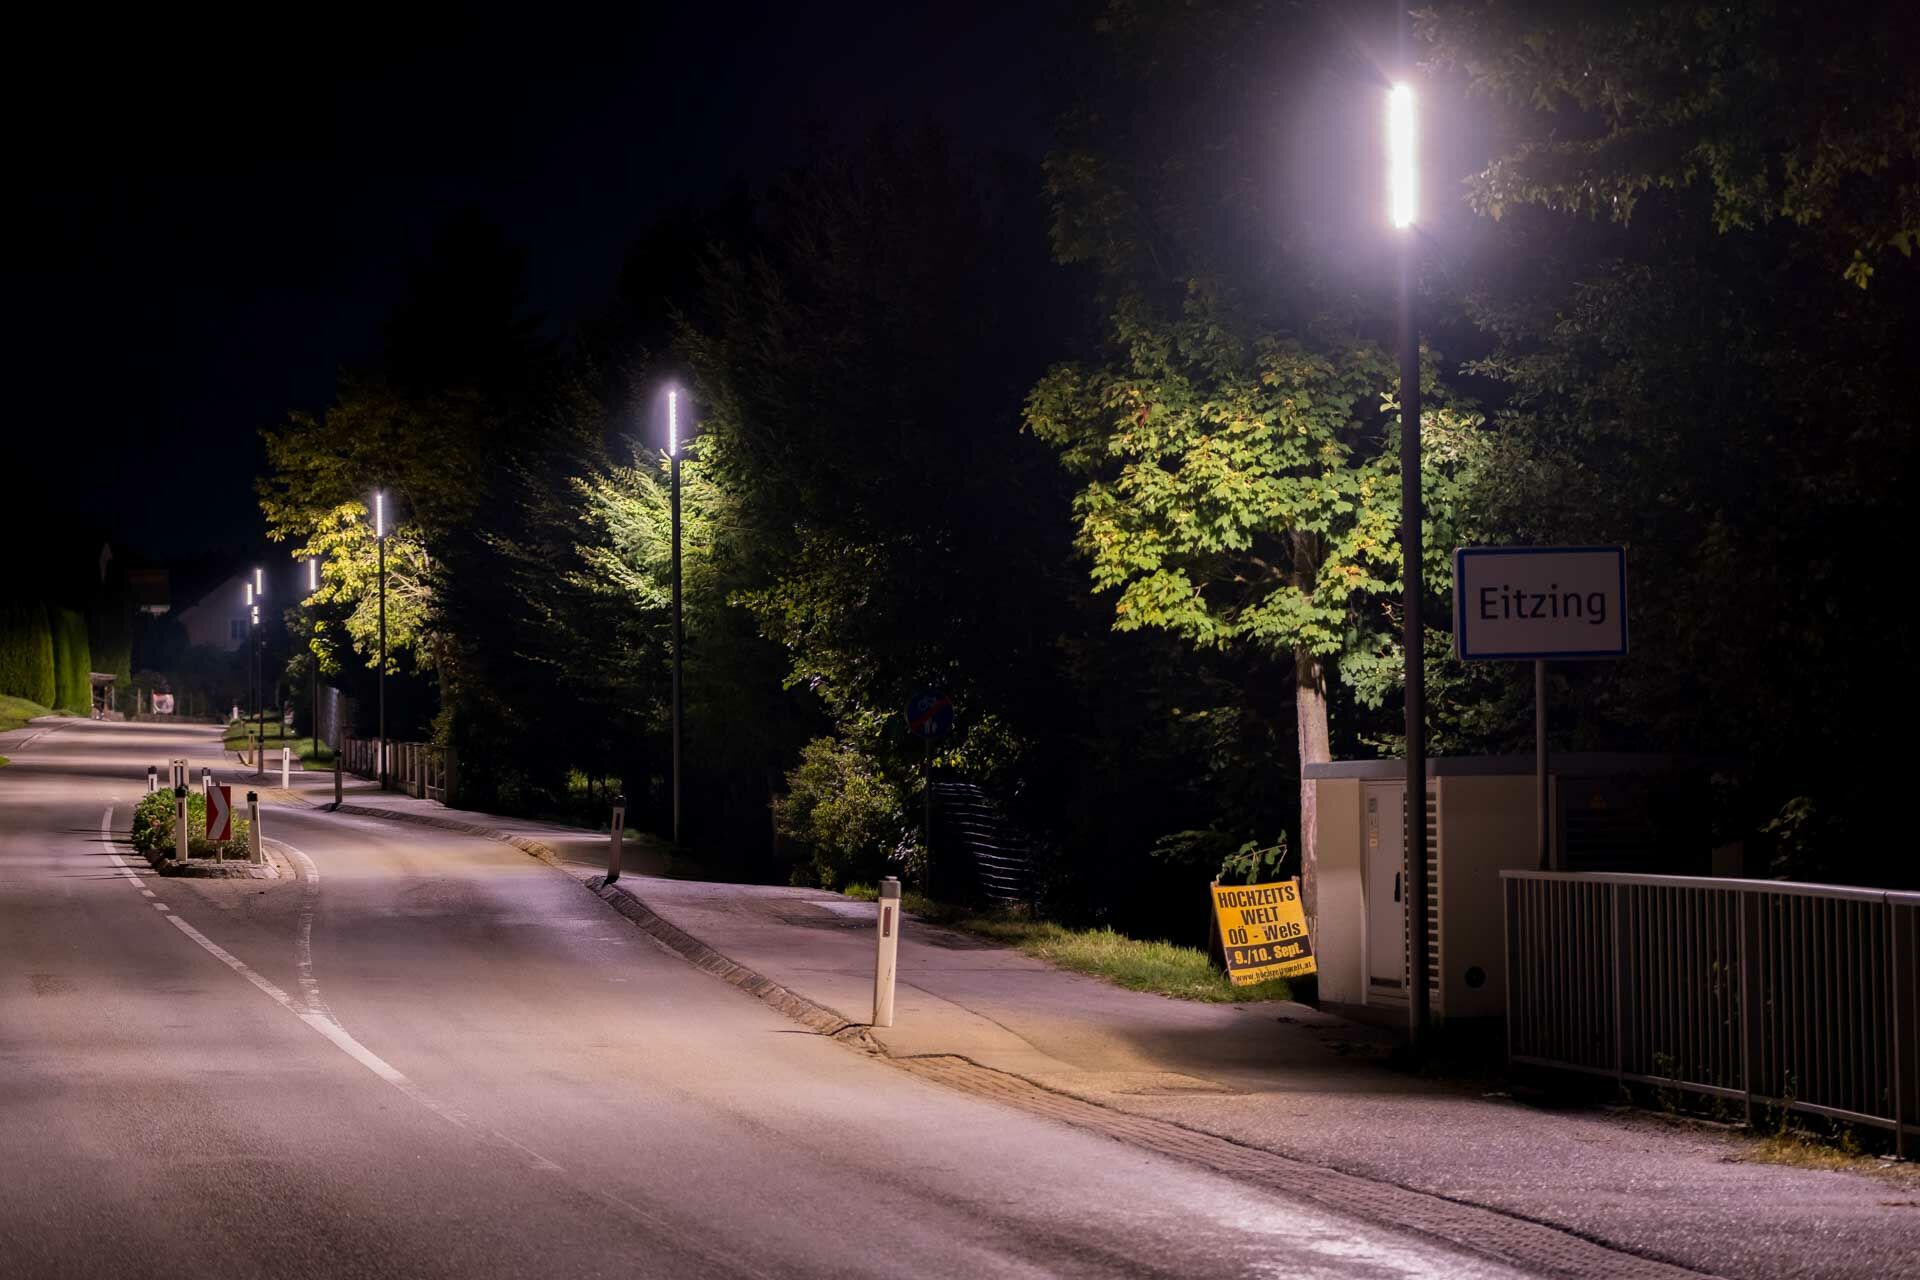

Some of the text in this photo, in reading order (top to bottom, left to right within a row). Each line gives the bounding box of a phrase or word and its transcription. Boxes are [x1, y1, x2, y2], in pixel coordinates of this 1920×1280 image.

[1480, 584, 1606, 624] Eitzing
[1217, 886, 1295, 908] HOCHZEITS
[1240, 906, 1279, 925] WELT
[1264, 922, 1301, 941] Wels
[1234, 942, 1304, 965] 9./10. Sept.
